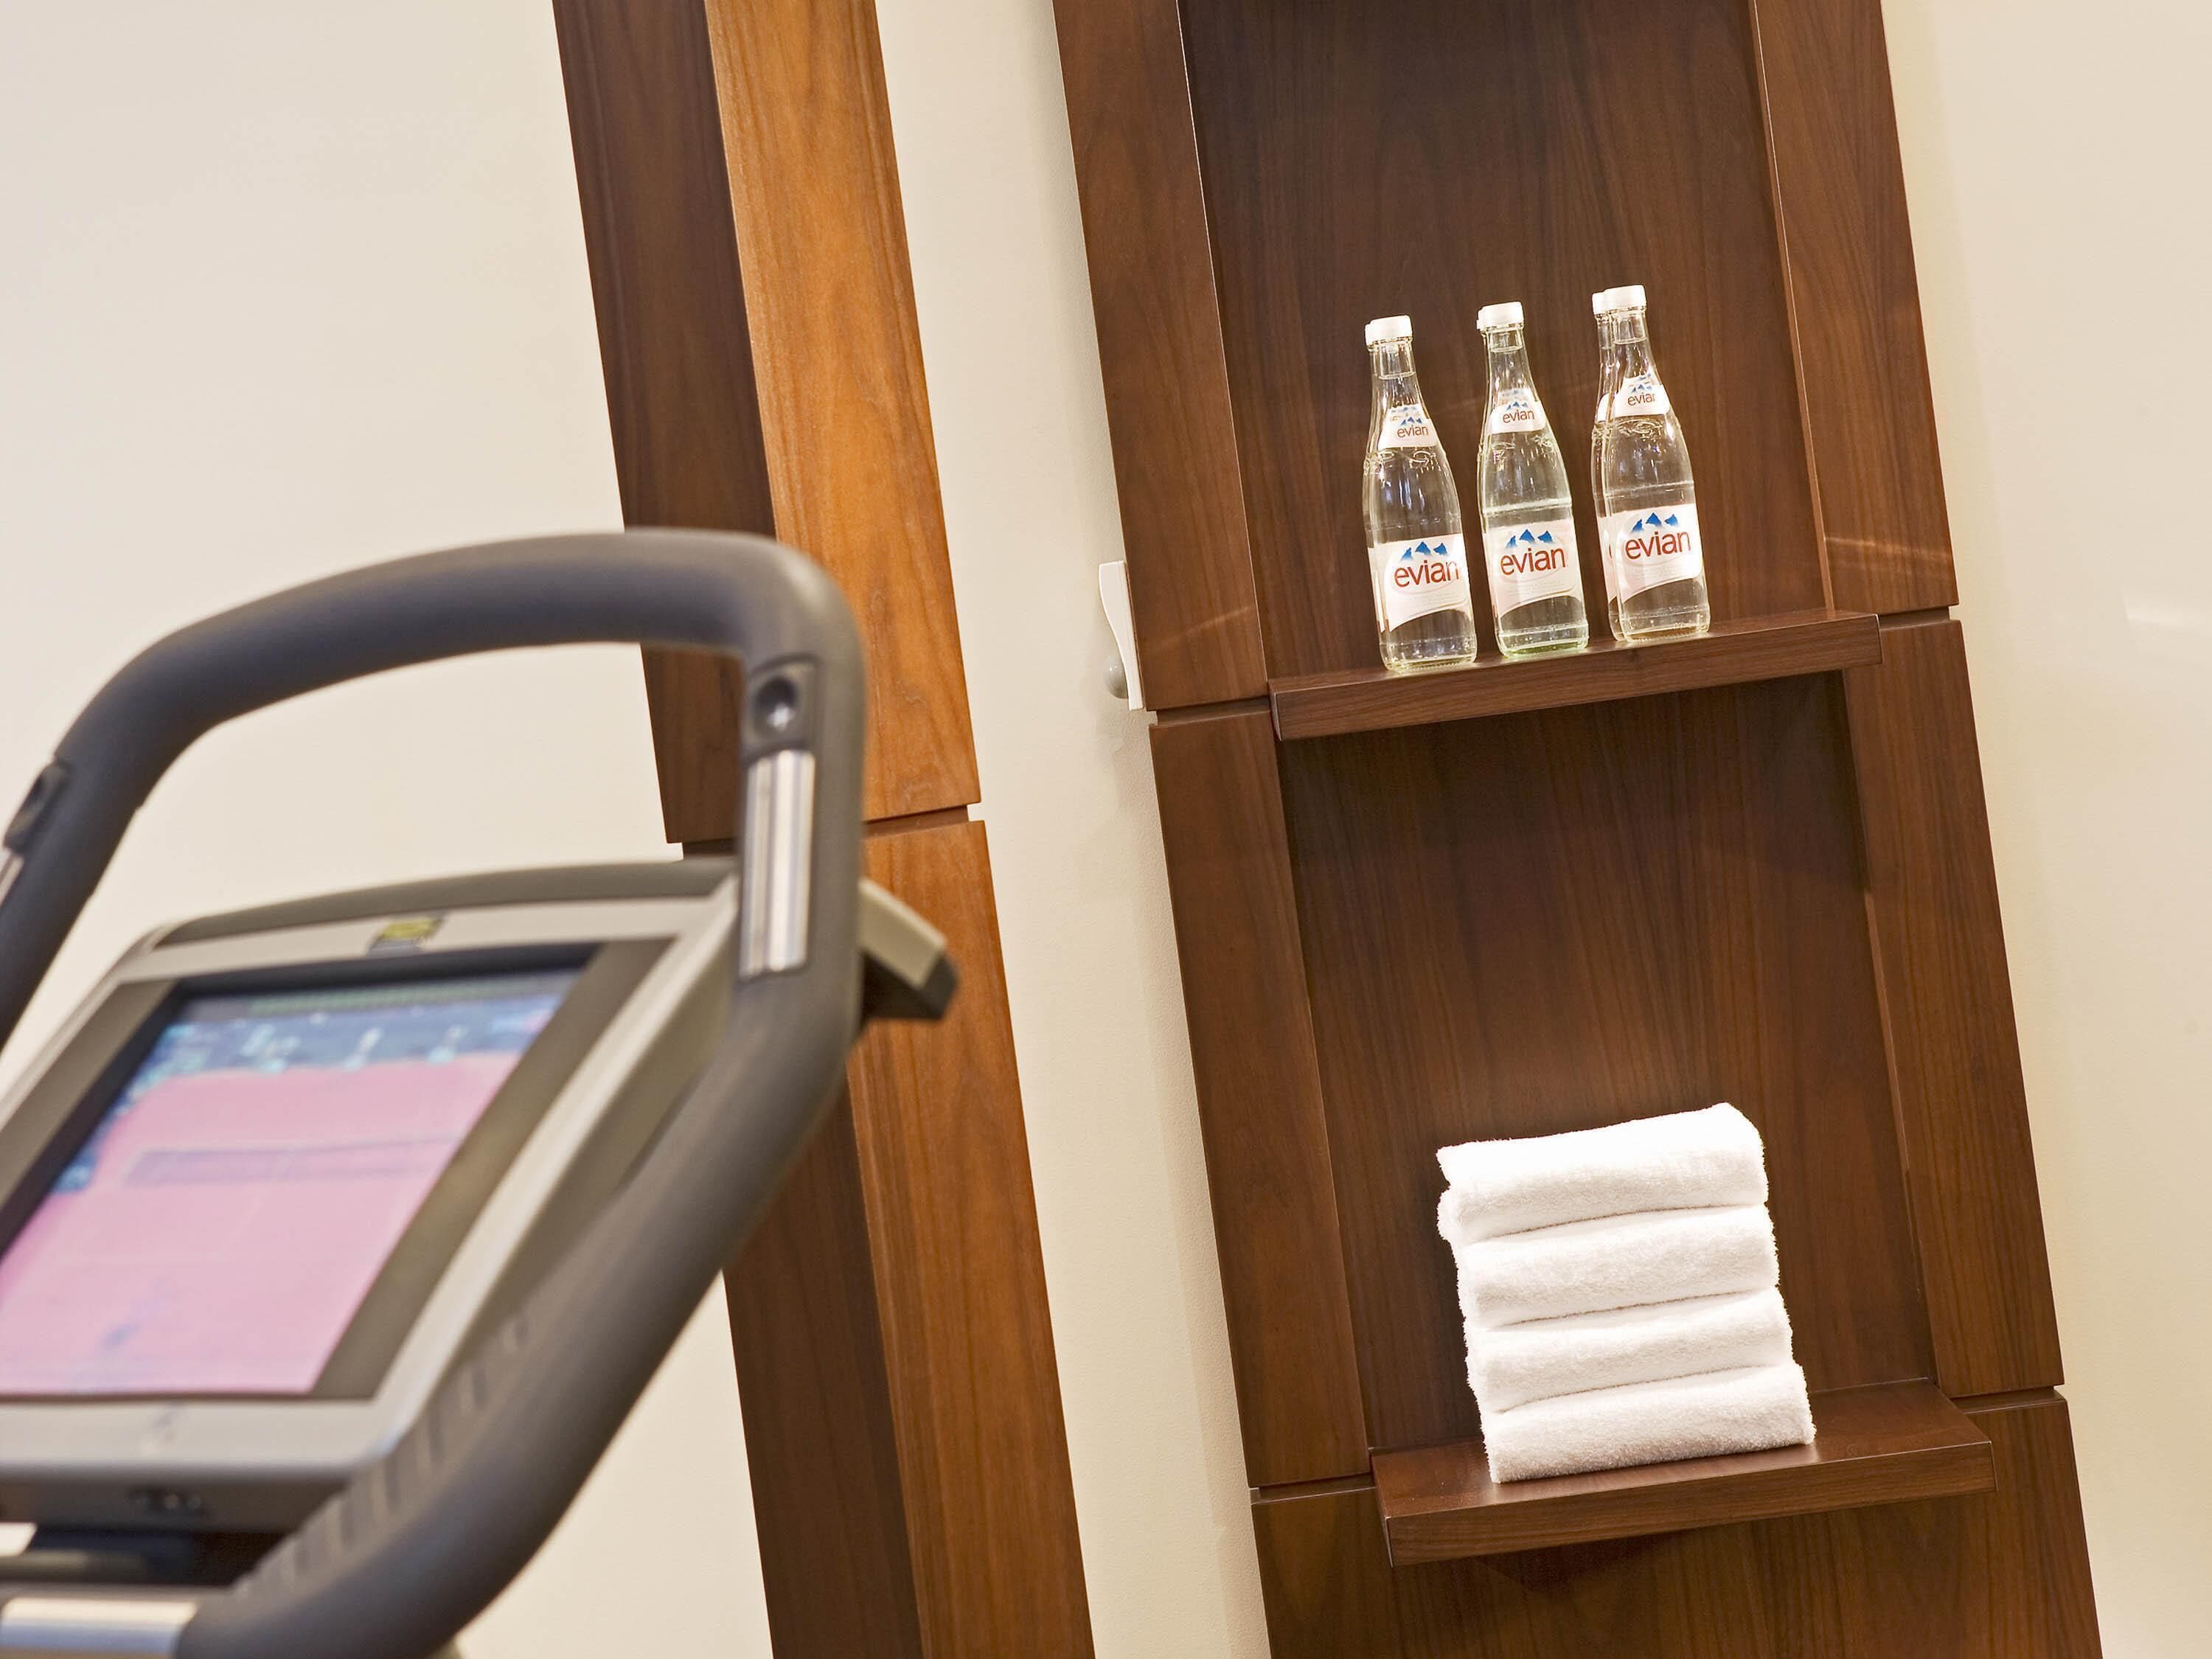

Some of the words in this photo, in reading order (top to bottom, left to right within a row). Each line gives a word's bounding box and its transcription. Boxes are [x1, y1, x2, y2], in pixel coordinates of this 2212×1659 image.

[1502, 409, 1535, 424] evian
[1397, 424, 1429, 438] evian
[1625, 531, 1691, 560] evian
[1394, 560, 1459, 588] evian
[1500, 548, 1566, 576] evian
